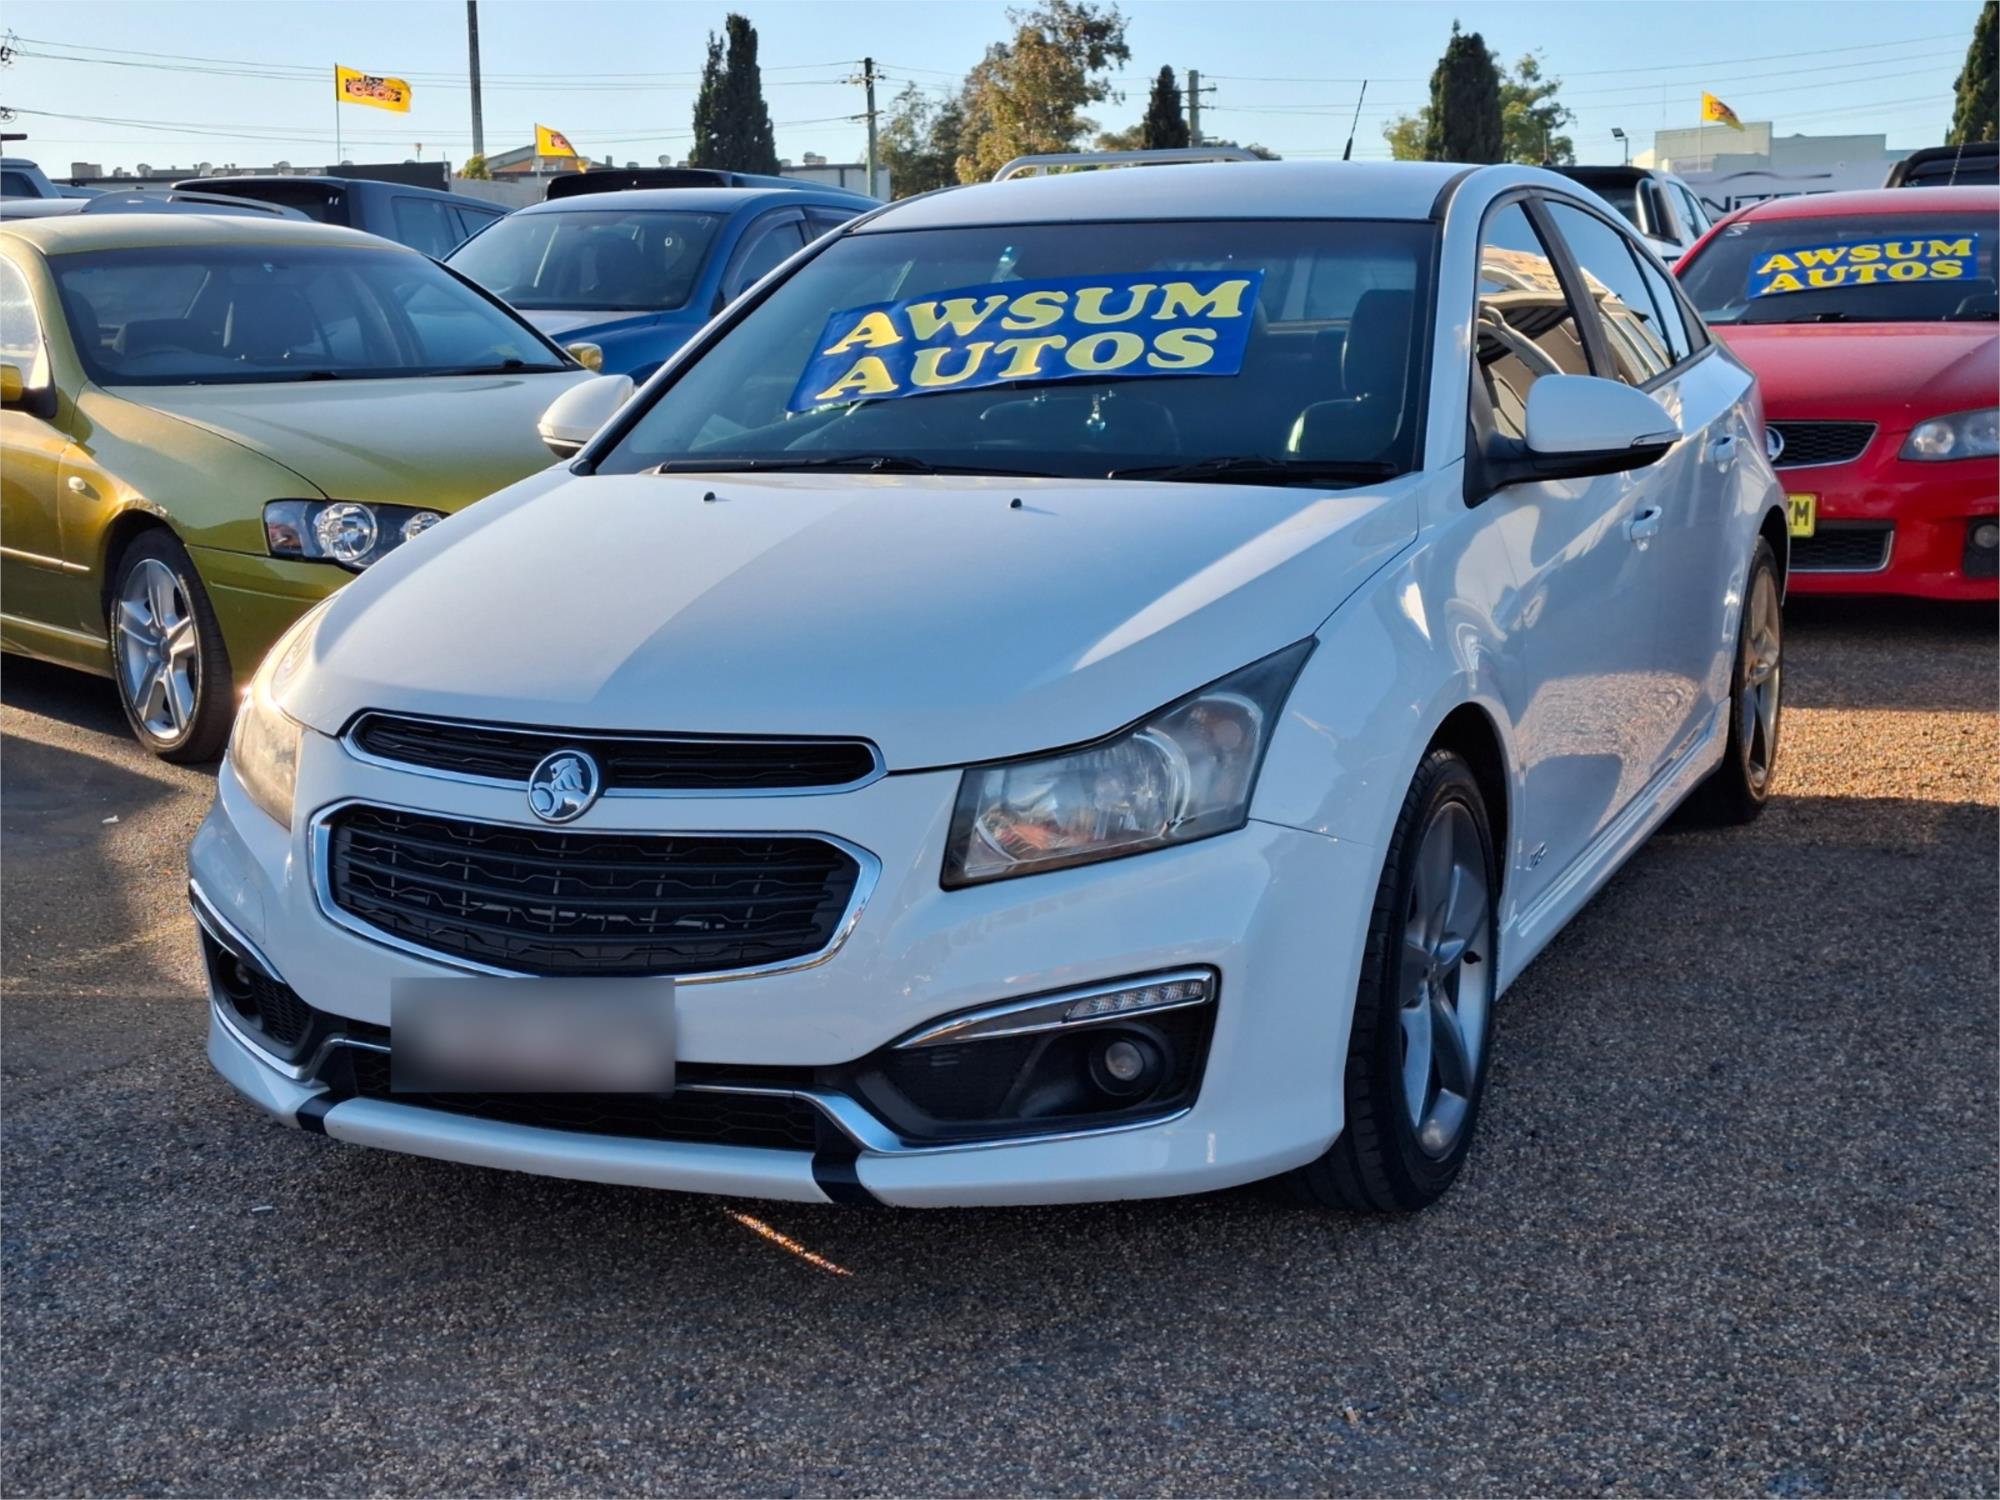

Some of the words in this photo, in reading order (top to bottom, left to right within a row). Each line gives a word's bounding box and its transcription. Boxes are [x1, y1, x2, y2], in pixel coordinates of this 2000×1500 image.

[1757, 239, 1973, 274] AWSUM
[1761, 260, 1963, 294] AUTOS
[824, 280, 1251, 356] AWSUM
[815, 328, 1217, 400] AUTOS
